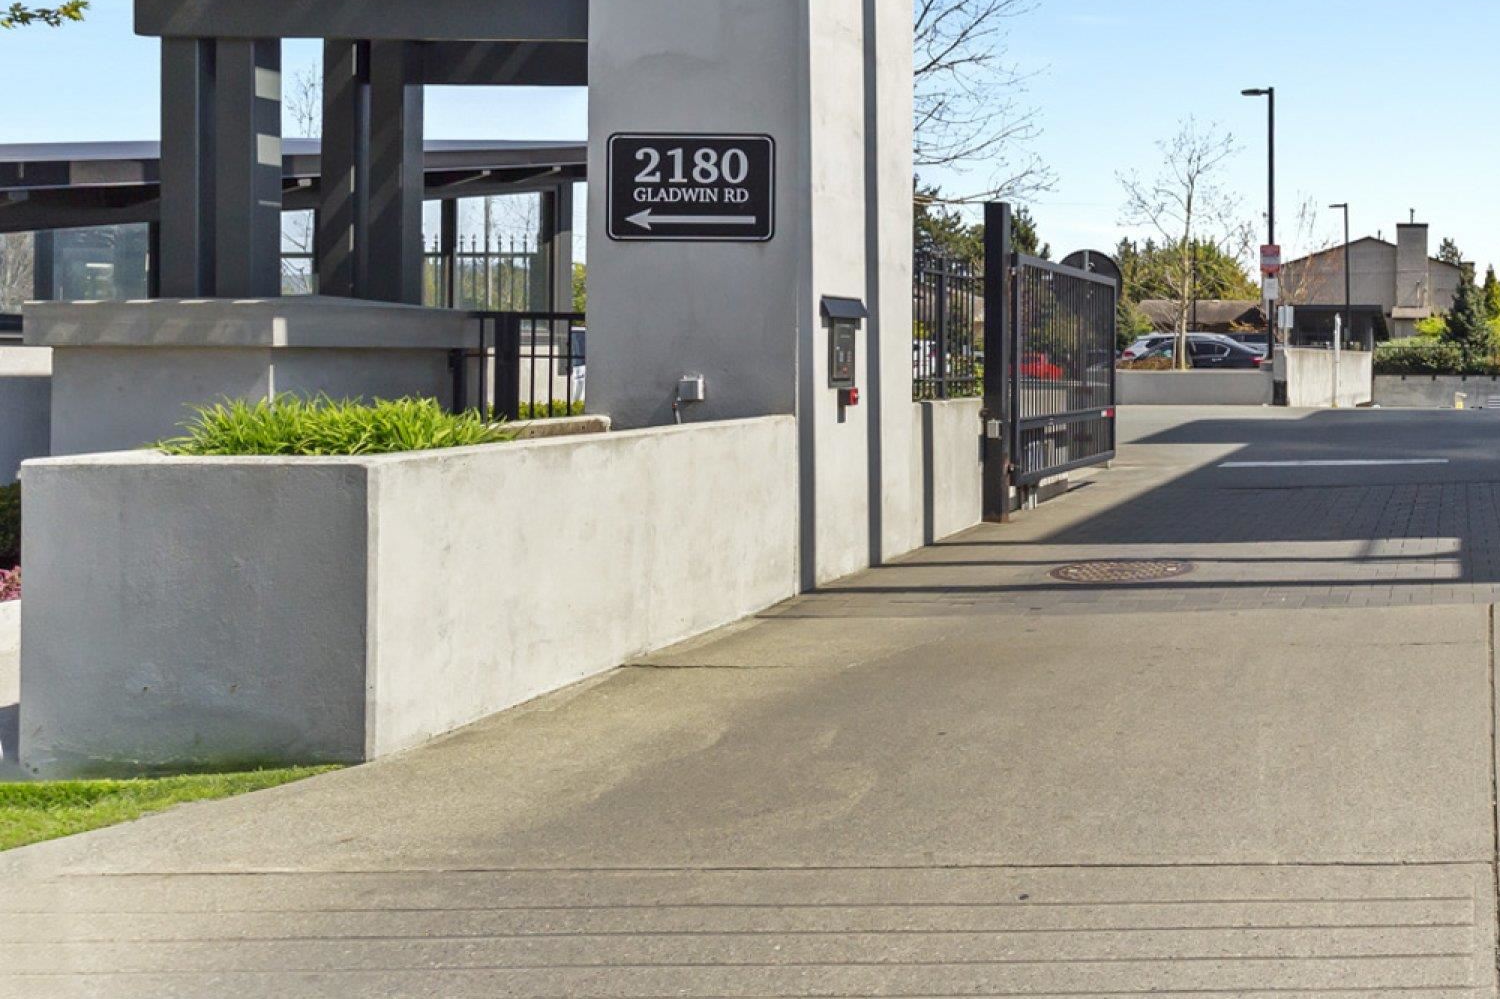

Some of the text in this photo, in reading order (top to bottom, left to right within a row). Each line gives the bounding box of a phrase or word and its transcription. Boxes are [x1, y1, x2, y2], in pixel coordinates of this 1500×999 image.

[634, 147, 749, 183] 2180
[633, 187, 749, 202] GLADWIN RD
